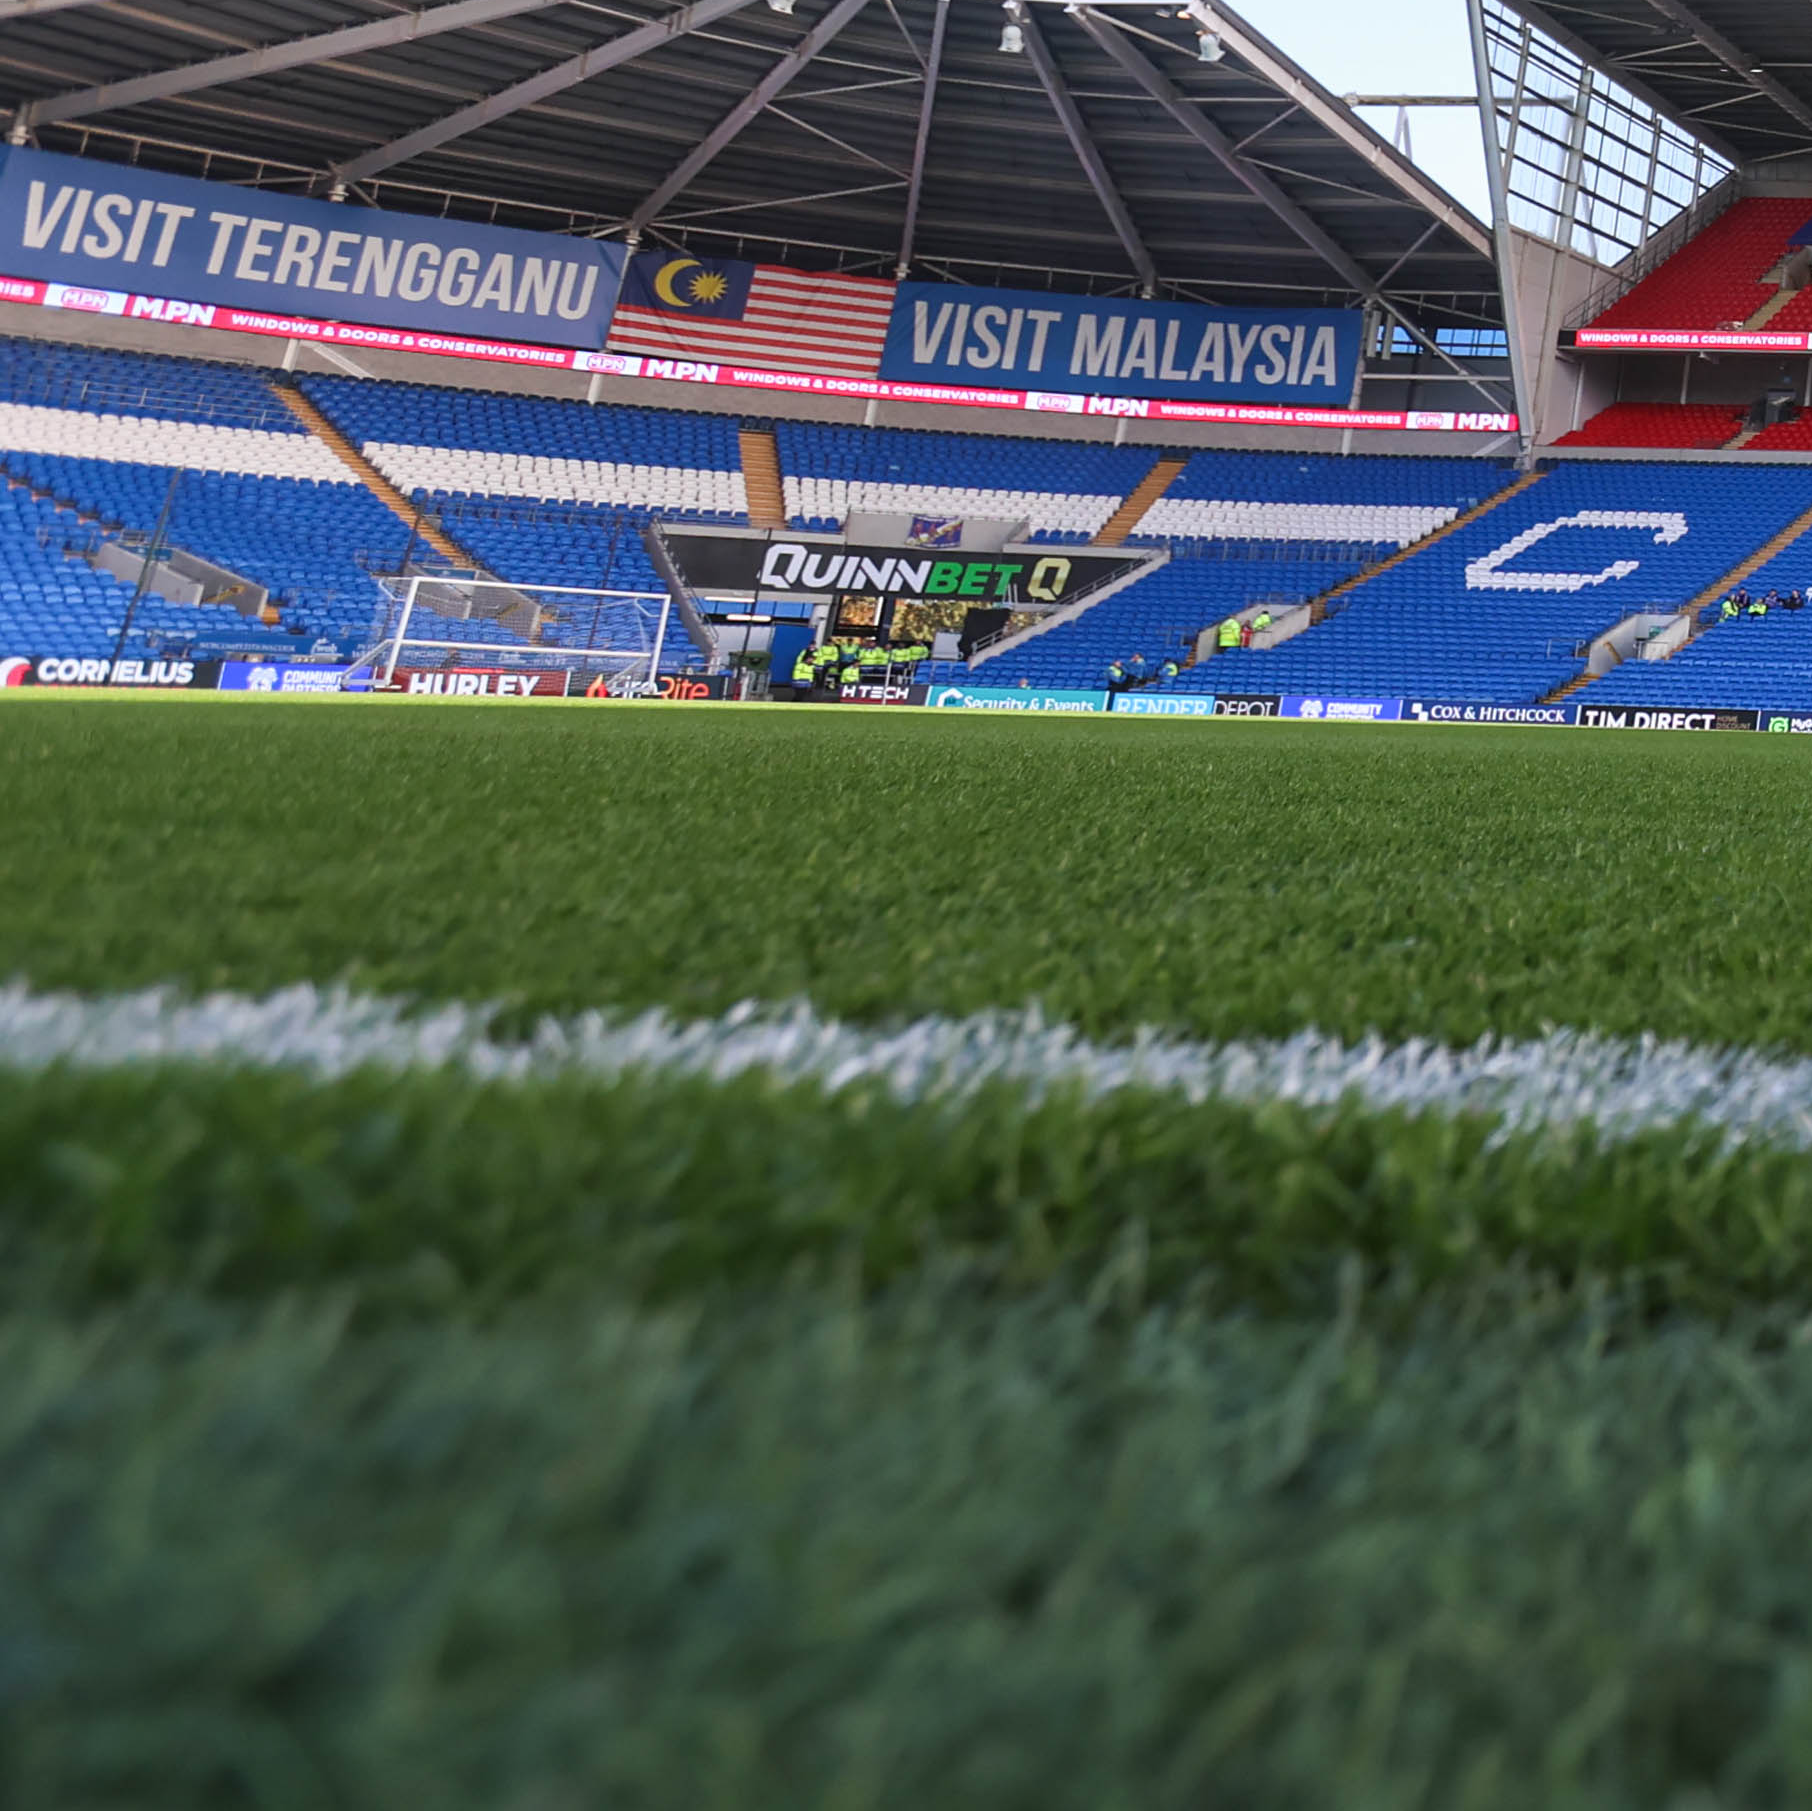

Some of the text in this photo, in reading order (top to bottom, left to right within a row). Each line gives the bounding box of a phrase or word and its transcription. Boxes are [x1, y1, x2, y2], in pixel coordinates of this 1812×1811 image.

[22, 180, 599, 320] VISIT TERENGGANU
[231, 313, 319, 335] WINDOWS
[339, 328, 399, 344] DOORS
[417, 337, 566, 363] CONSERVATORIES
[913, 300, 1337, 386] VISIT MALAYSIA
[1580, 333, 1638, 342] WINDOWS
[1701, 335, 1801, 345] CONSERVATORIES
[733, 371, 810, 387] WINDOWS
[826, 380, 878, 394] DOORS
[892, 386, 1019, 405] CONSERVATORIES
[1161, 405, 1225, 418] WINDOWS
[1238, 410, 1283, 422] DOORS
[1295, 413, 1401, 424] CONSERVATORIES
[760, 543, 1023, 596] QUINNBET
[38, 659, 195, 684] CORNELIUS
[408, 673, 540, 697] HURLEY
[963, 695, 1026, 711] Security
[1044, 698, 1095, 712] Events
[1113, 696, 1210, 715] RENDER
[1213, 701, 1274, 716] DEPOT
[1326, 702, 1383, 715] COMMUNITY
[1430, 705, 1565, 723] COX & HITCHCOCK
[1633, 711, 1716, 731] DIRECT
